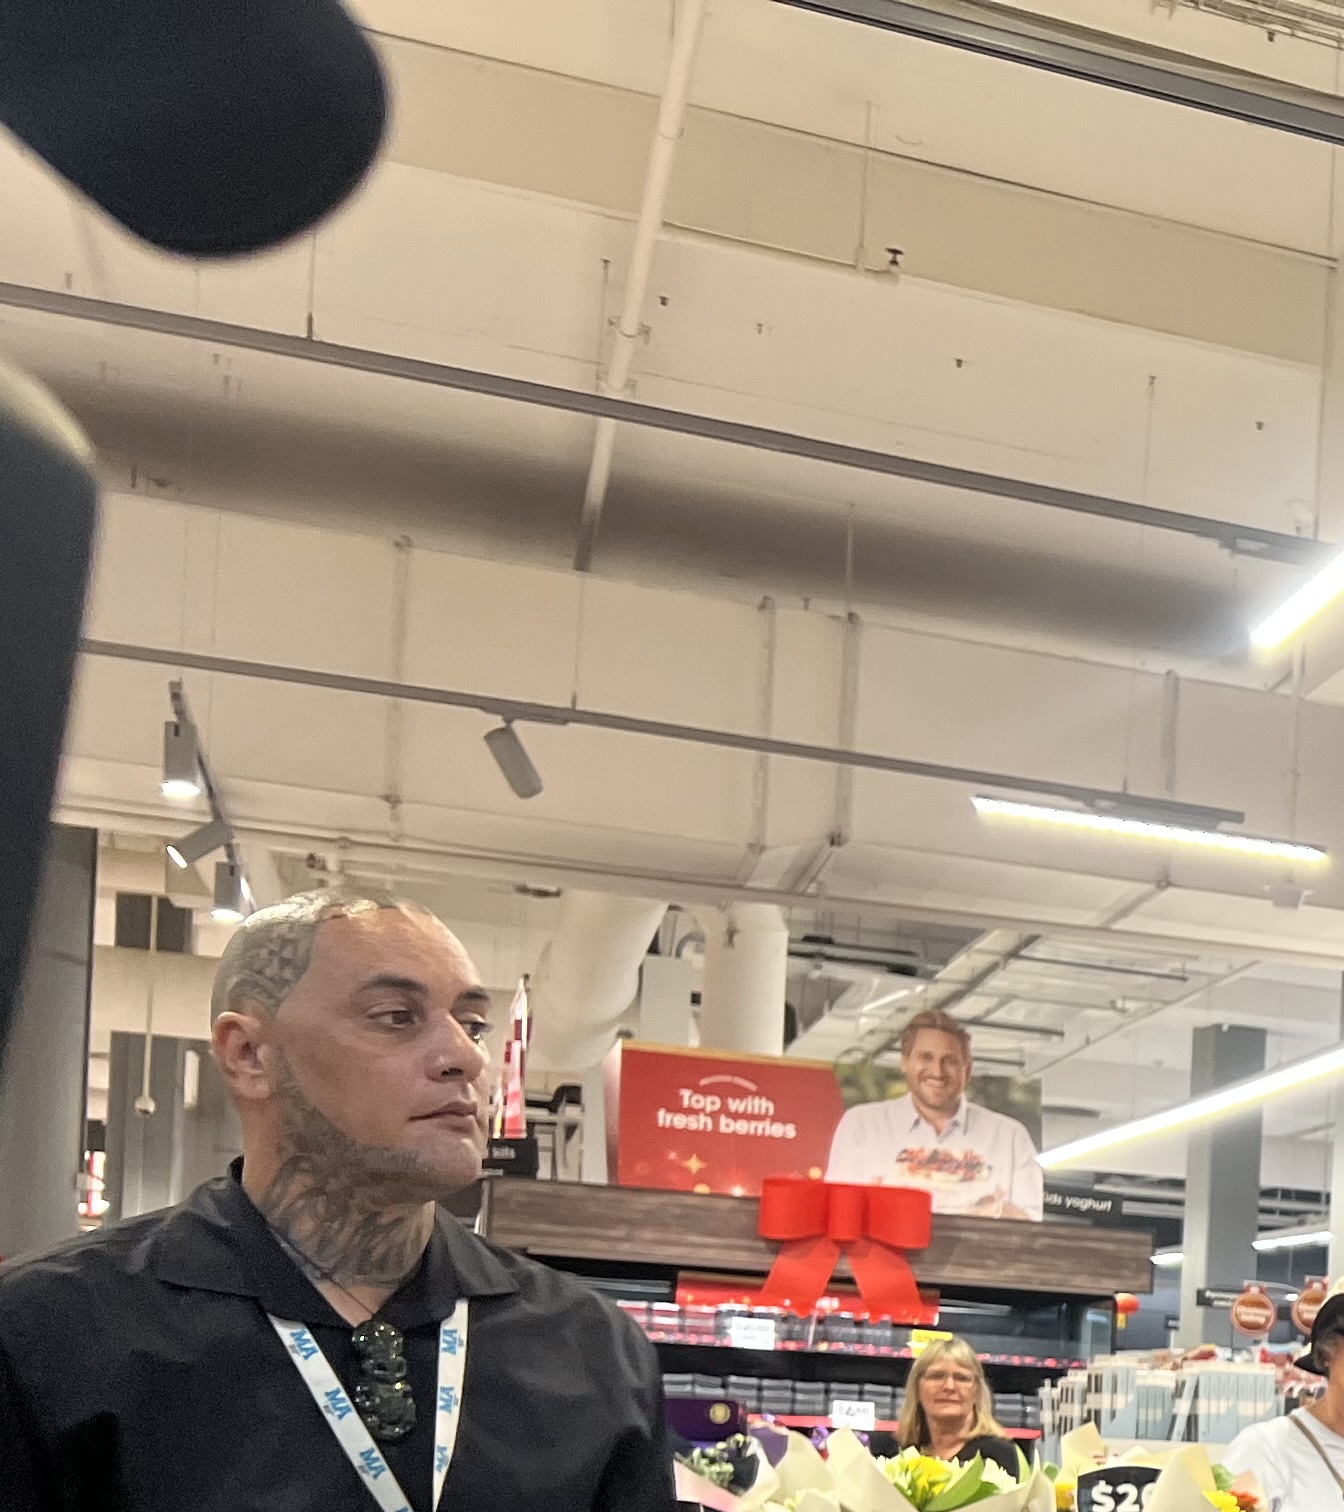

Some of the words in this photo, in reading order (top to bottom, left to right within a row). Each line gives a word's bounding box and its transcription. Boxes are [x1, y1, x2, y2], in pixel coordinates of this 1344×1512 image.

[680, 1088, 721, 1113] Top
[728, 1095, 775, 1116] with
[657, 1108, 713, 1132] fresh
[719, 1114, 797, 1139] berries
[1066, 1196, 1113, 1212] yoghurt
[290, 1328, 319, 1360] MA
[324, 1387, 353, 1420] MA
[359, 1447, 386, 1480] MA
